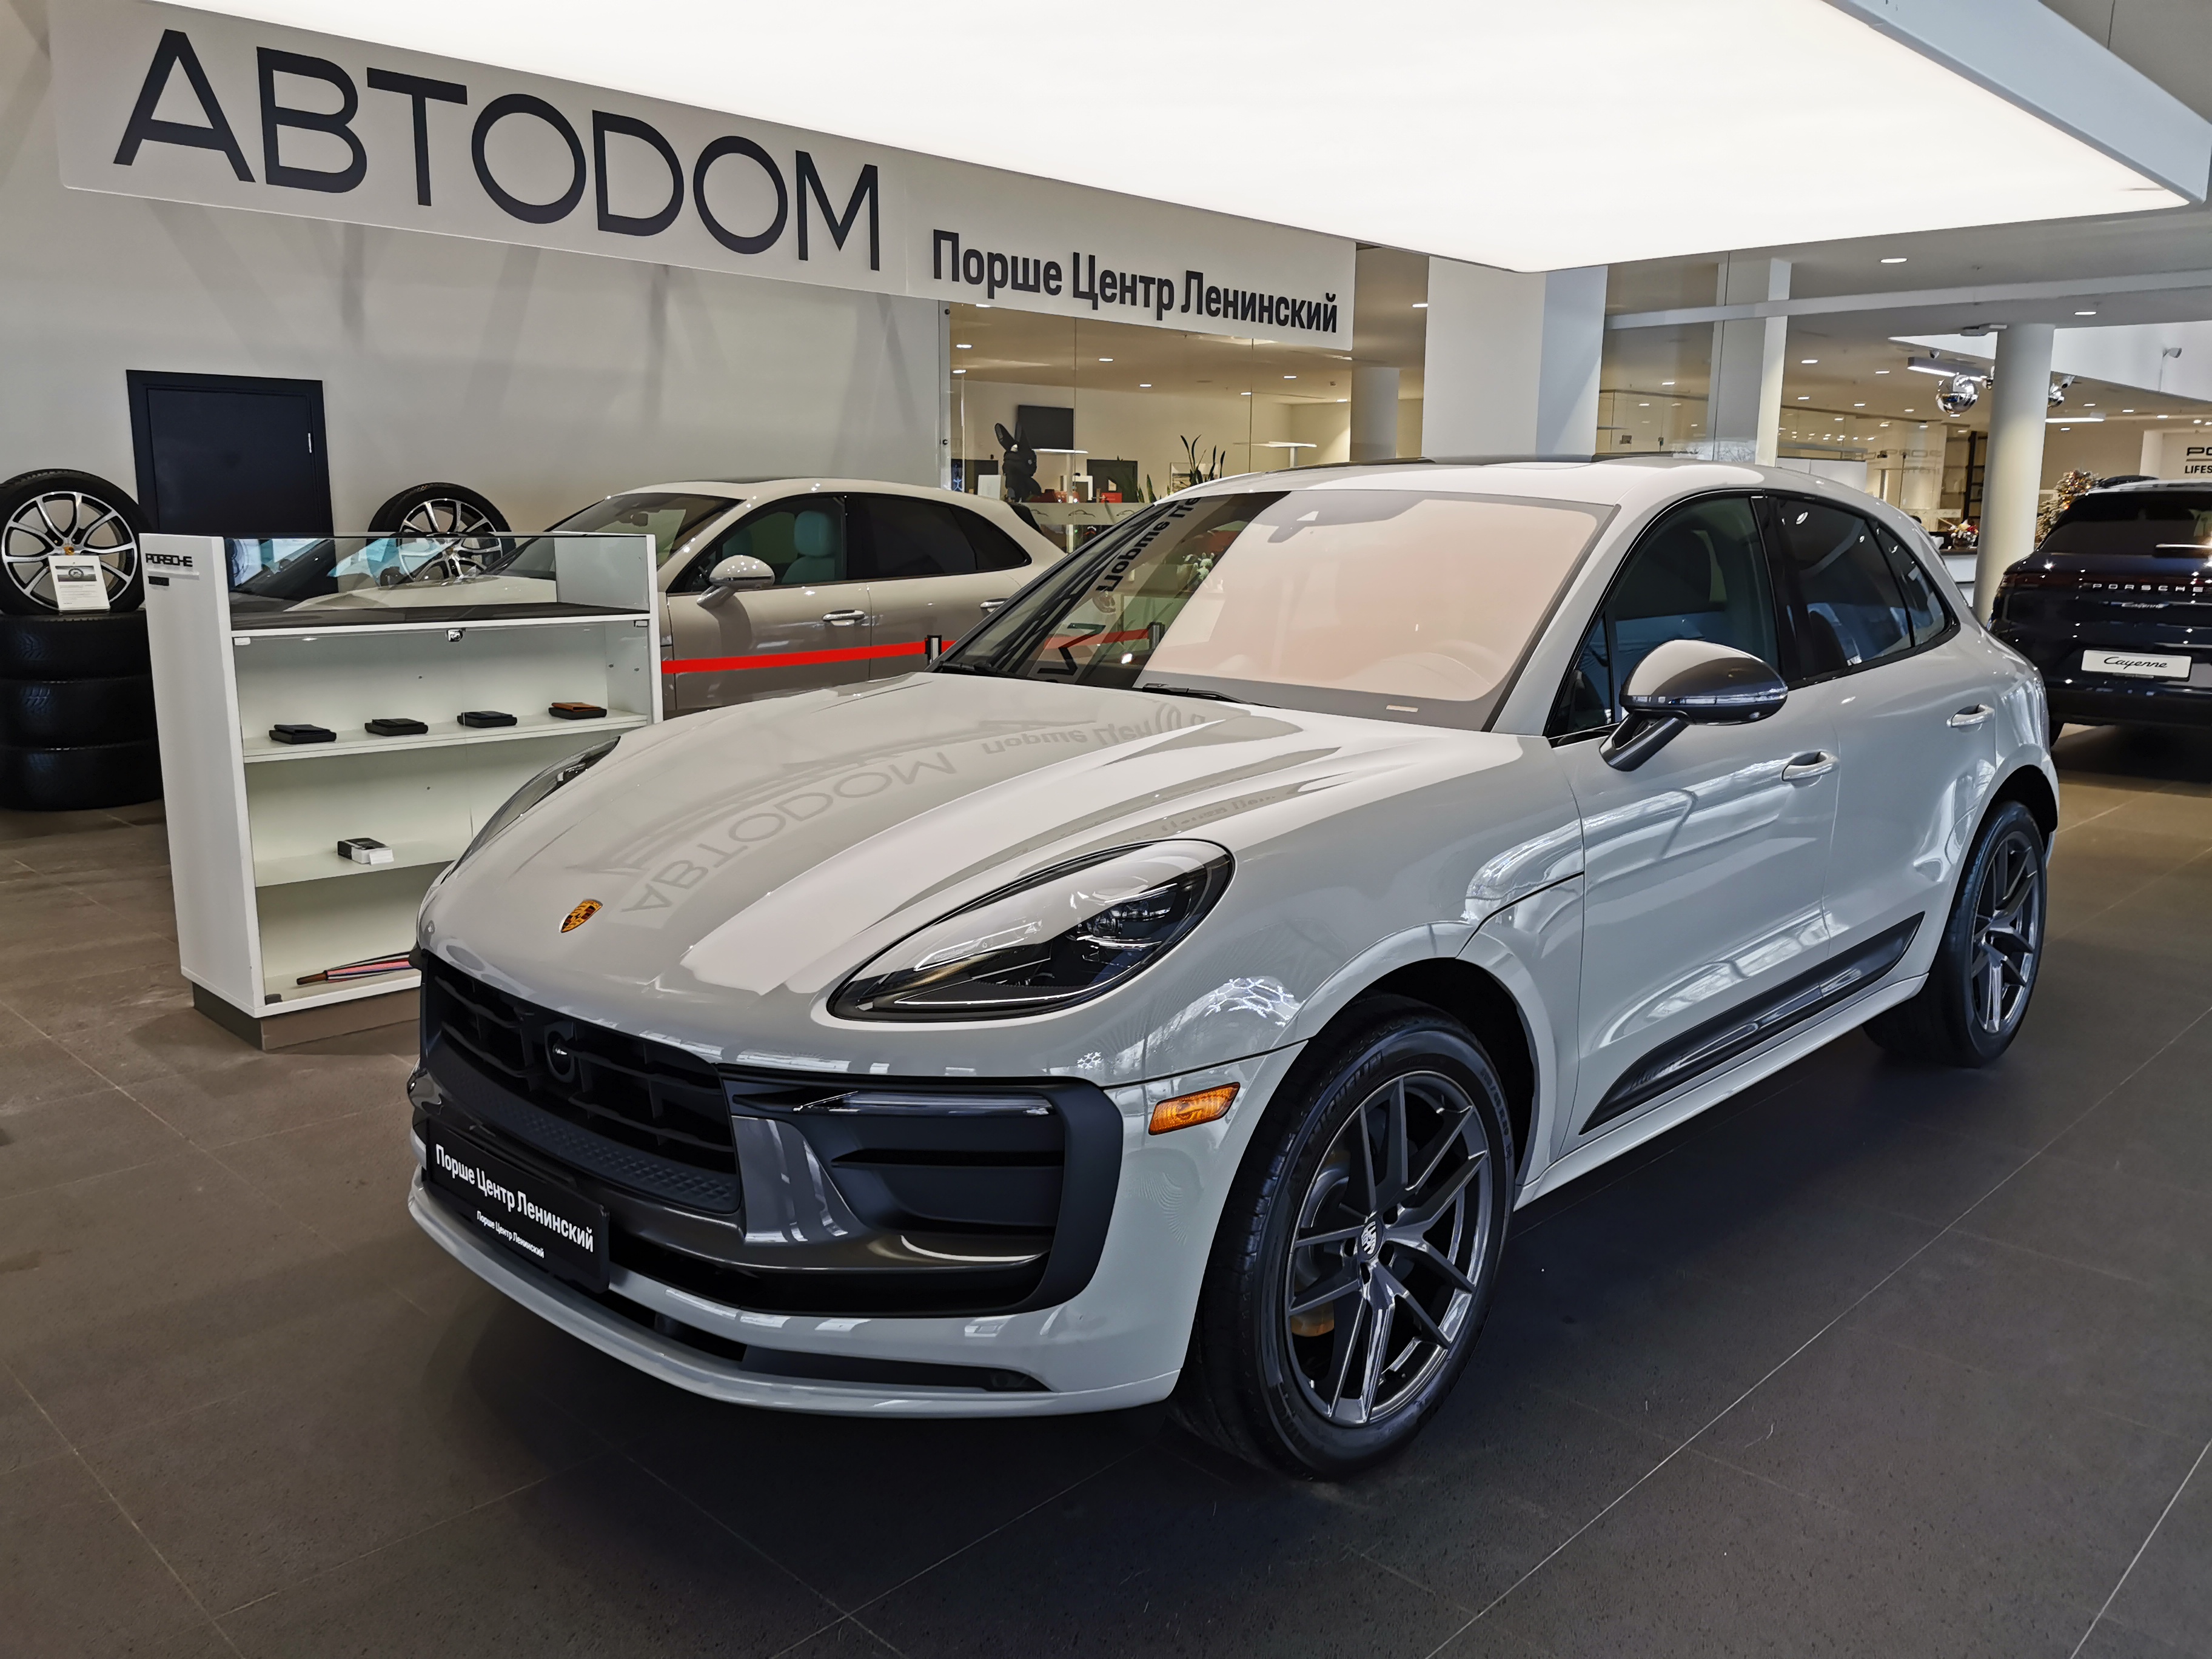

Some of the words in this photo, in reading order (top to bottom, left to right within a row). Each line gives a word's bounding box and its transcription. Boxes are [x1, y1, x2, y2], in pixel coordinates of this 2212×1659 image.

[933, 229, 1062, 300] Порше
[1073, 252, 1175, 321] Центр
[1181, 270, 1338, 333] Ленинский
[145, 552, 193, 568] PORSCHE
[2093, 583, 2204, 592] PORSCHE
[2103, 656, 2168, 670] Cayenne
[435, 1144, 475, 1185] Порше
[476, 1167, 515, 1212] Центр
[517, 1190, 594, 1253] Ленинский
[477, 1210, 495, 1229] Порше
